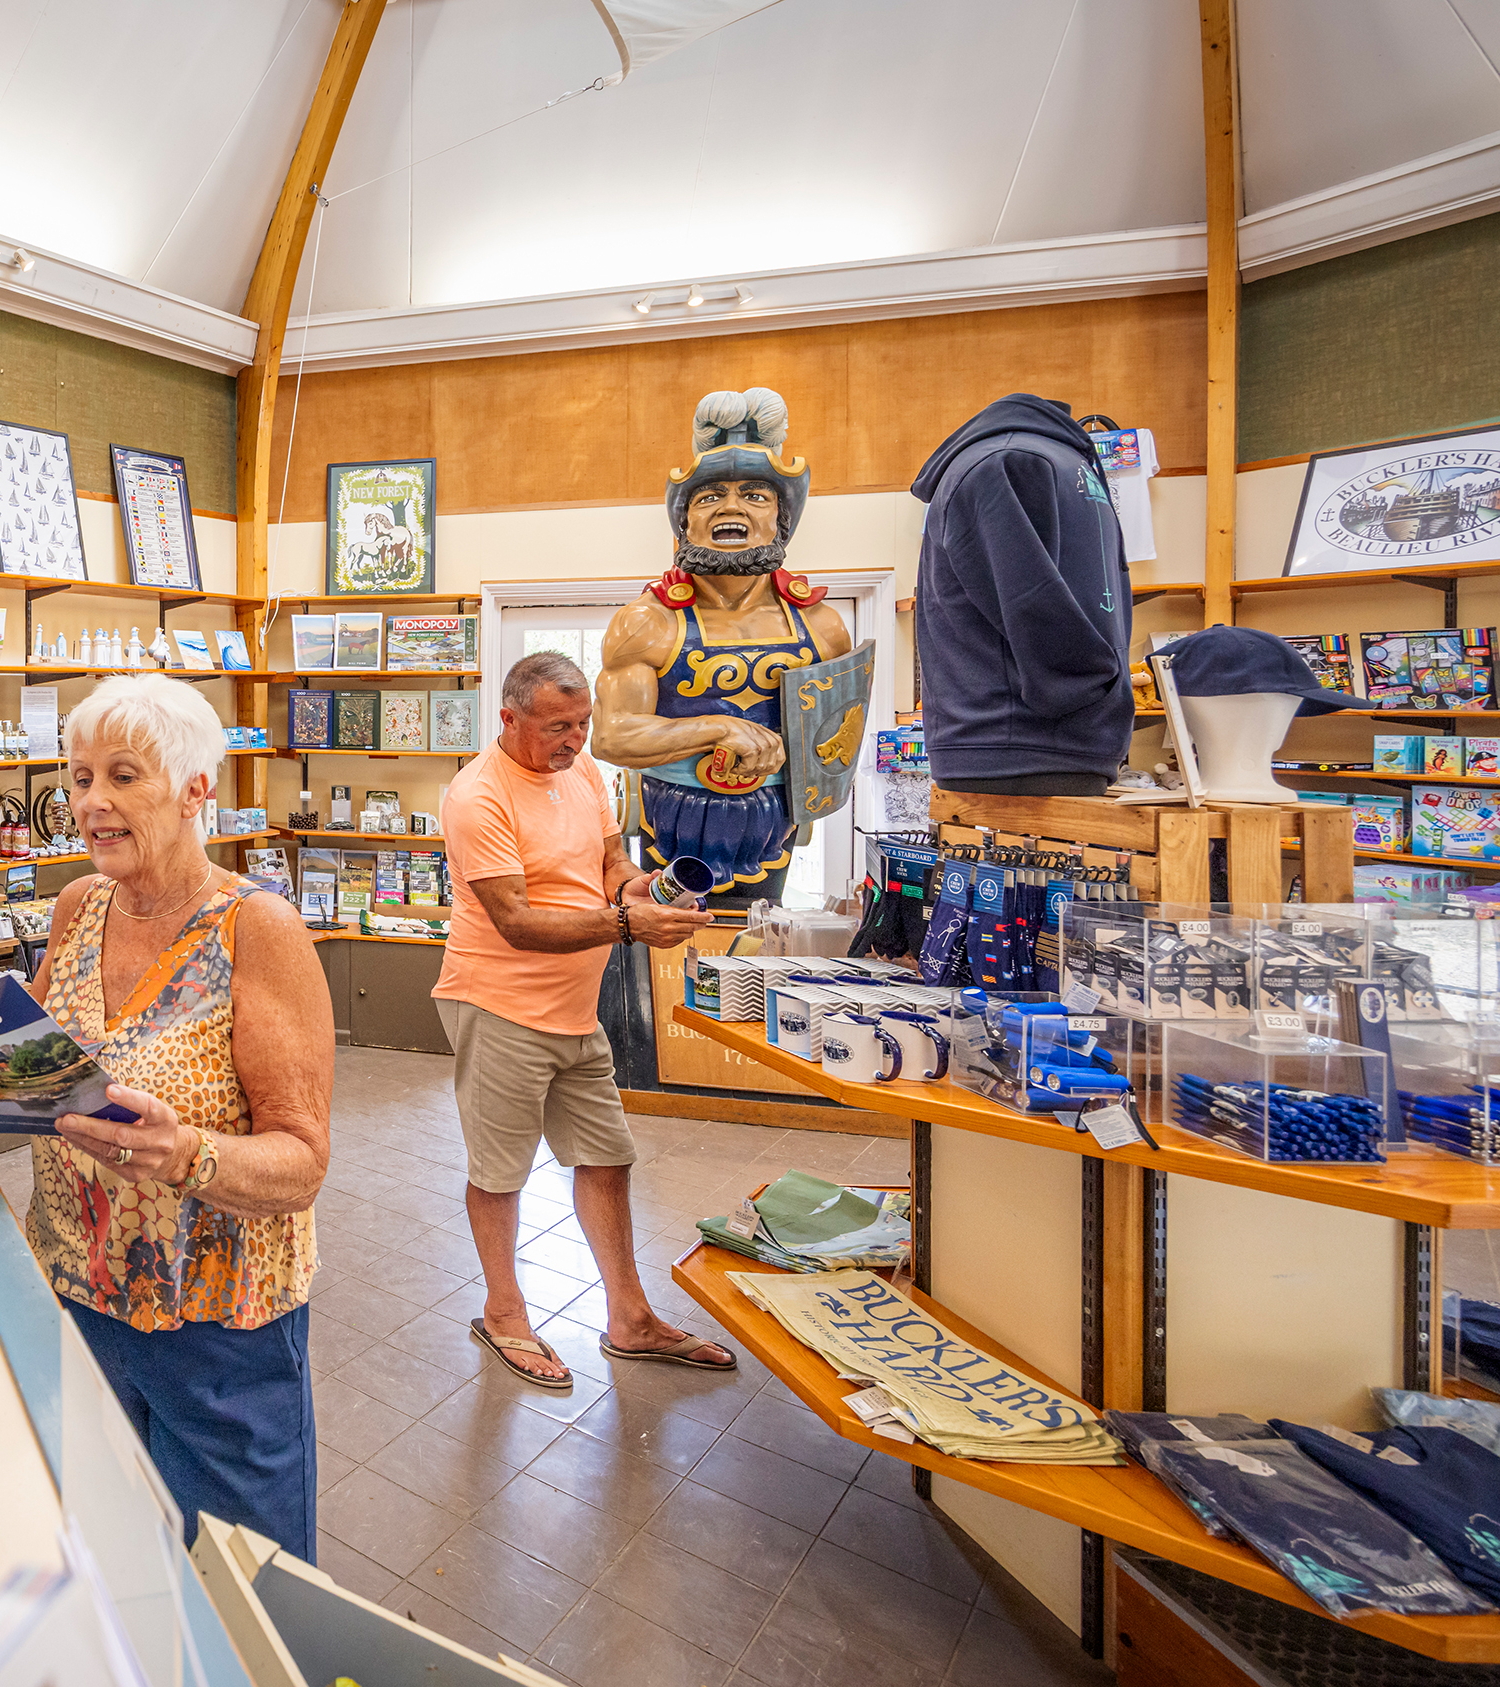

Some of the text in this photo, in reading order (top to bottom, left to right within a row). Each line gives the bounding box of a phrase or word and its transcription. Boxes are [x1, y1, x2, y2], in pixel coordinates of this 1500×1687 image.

[1336, 451, 1467, 502] BUCKLER'S
[352, 484, 412, 500] NEW FOREST
[1326, 527, 1441, 556] BEAULIEU
[395, 618, 460, 631] MONOPOLY
[1468, 738, 1498, 747] Pirate
[1448, 789, 1482, 800] TOWER
[1446, 796, 1482, 811] DROP
[897, 850, 933, 862] STARBOARD
[1182, 923, 1209, 933] £4.00
[1292, 924, 1321, 934] £4.00
[1072, 1019, 1101, 1029] £4.75
[1266, 1016, 1300, 1028] £3.00
[837, 1279, 1084, 1429] BUCKLER'S
[828, 1319, 975, 1403] HARD
